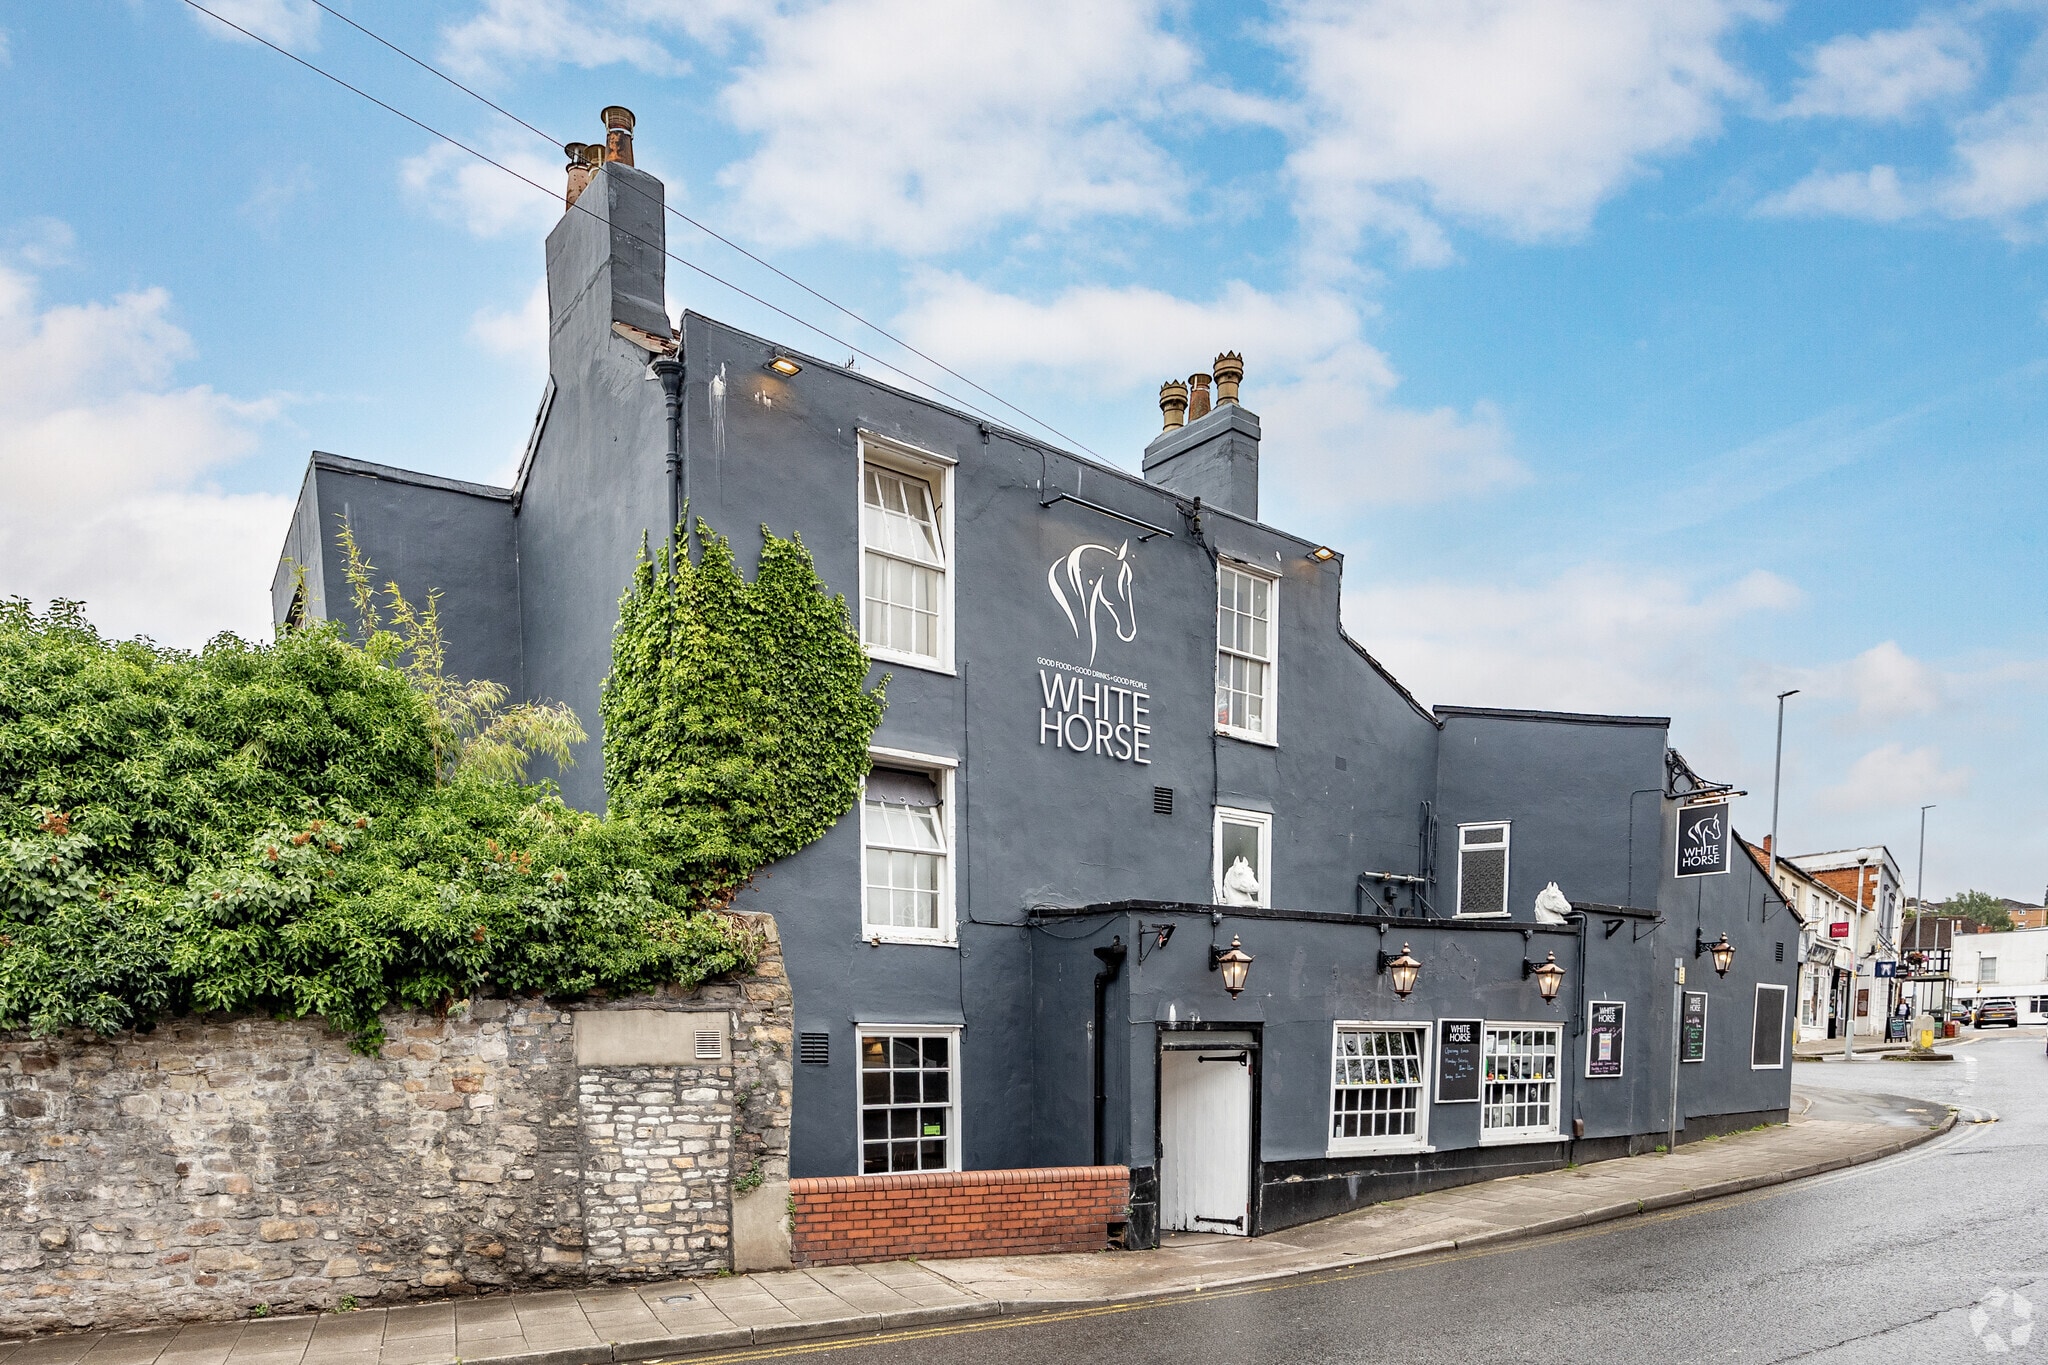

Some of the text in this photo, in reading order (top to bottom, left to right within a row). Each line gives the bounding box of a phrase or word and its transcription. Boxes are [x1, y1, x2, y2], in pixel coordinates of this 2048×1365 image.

[1036, 656, 1148, 690] GOOD FOOD GOOD DRINKS GOOD PEOPLE
[1039, 669, 1151, 730] WHITE
[1039, 707, 1152, 765] HORSE
[1684, 844, 1719, 858] WHITE
[1682, 854, 1720, 867] HORSE
[1599, 1006, 1616, 1015] WHITE
[1598, 1014, 1616, 1023] HORSE
[1450, 1024, 1471, 1034] WHITE
[1449, 1033, 1471, 1042] HORSE
